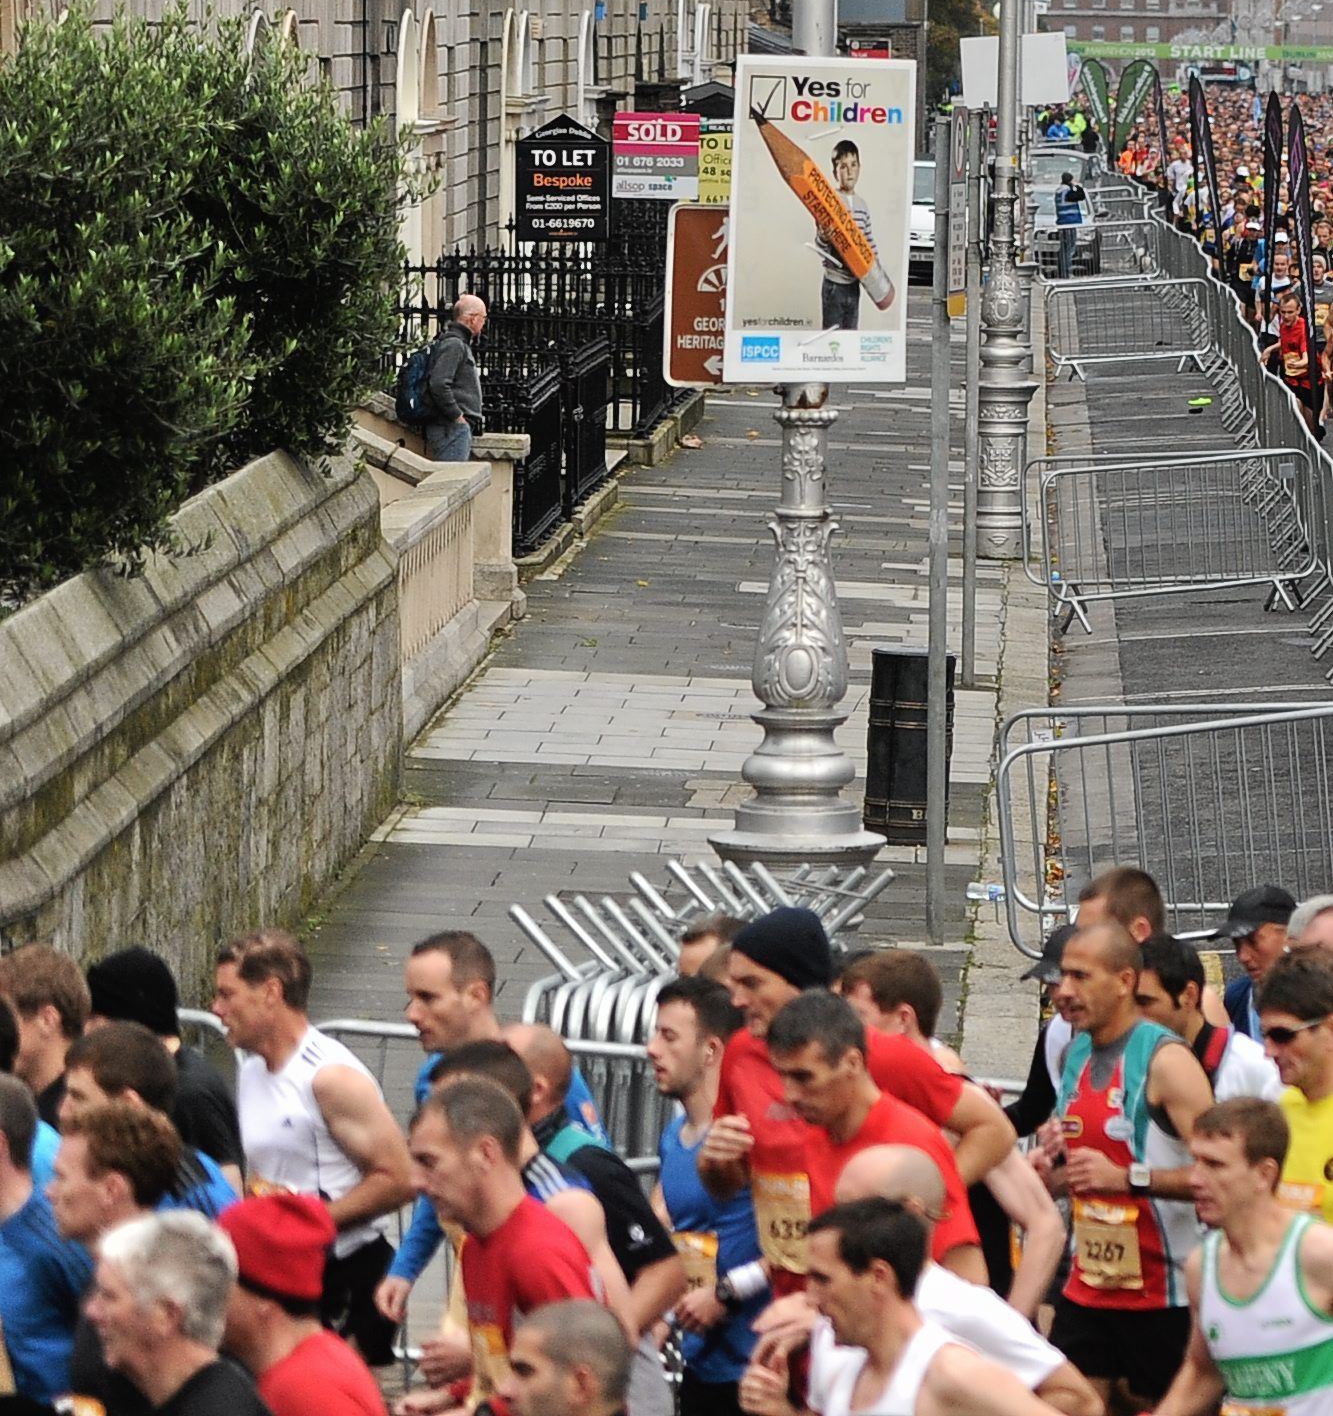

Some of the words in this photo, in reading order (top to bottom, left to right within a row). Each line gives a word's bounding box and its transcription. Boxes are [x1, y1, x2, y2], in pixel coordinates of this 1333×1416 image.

[1170, 46, 1225, 59] START
[1229, 47, 1266, 59] LINE
[791, 76, 841, 98] Yes
[846, 77, 871, 99] for
[791, 100, 903, 124] Children
[627, 123, 682, 142] SOLD
[531, 149, 557, 166] TO
[562, 149, 596, 166] LET
[616, 157, 629, 166] 01
[656, 157, 684, 168] 2033
[533, 173, 593, 190] Bespoke
[616, 180, 645, 193] allsop
[648, 183, 673, 191] space
[808, 168, 848, 225] PROTECTING
[803, 190, 835, 231] STARTS
[832, 227, 853, 253] HERE
[694, 317, 725, 332] GEOR
[677, 335, 725, 350] HERITAG
[742, 345, 779, 358] ISPCC
[802, 352, 844, 363] Barnardos
